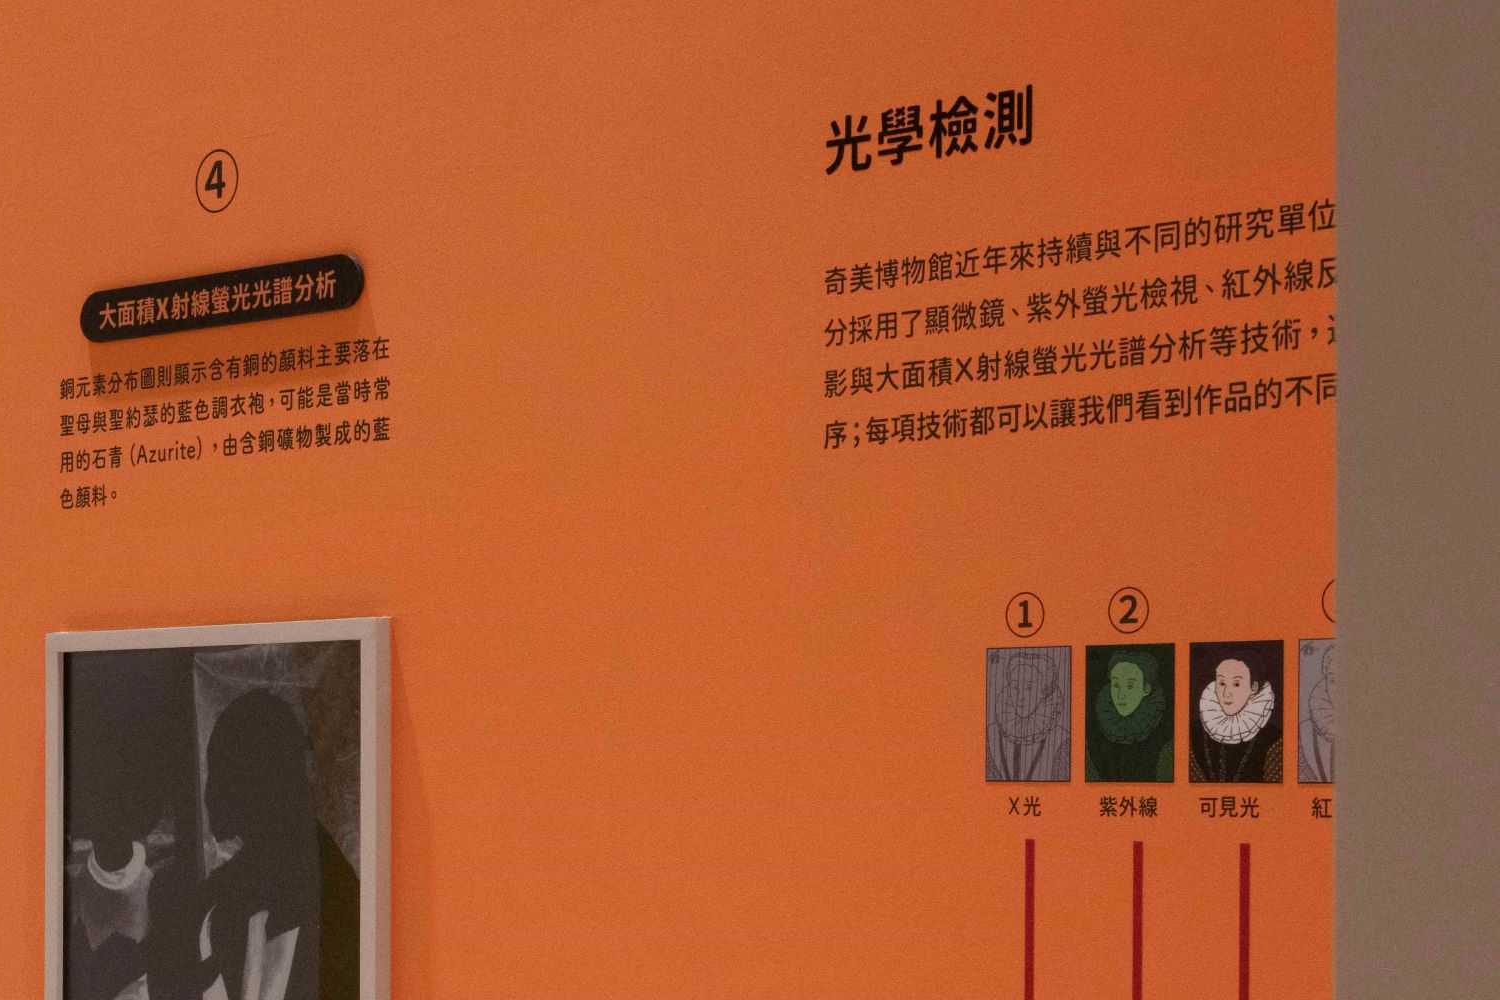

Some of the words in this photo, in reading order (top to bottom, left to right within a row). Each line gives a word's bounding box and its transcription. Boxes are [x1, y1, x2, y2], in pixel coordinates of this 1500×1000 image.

[825, 83, 1034, 176] 光學檢測
[824, 198, 1336, 297] 奇美博物館近年來持續與不同的研究單位
[99, 269, 337, 330] 大面積X射線螢光光譜分析
[59, 336, 390, 401] 銅元素分布圖則顯示含有銅的顏料主要落在
[824, 314, 1336, 399] 影與大面積X射線螢光光譜分析等技術，
[59, 484, 117, 510] 色顏料。
[1008, 796, 1041, 818] X光
[1099, 796, 1158, 819] 紫外線
[1200, 796, 1260, 819] 可見光
